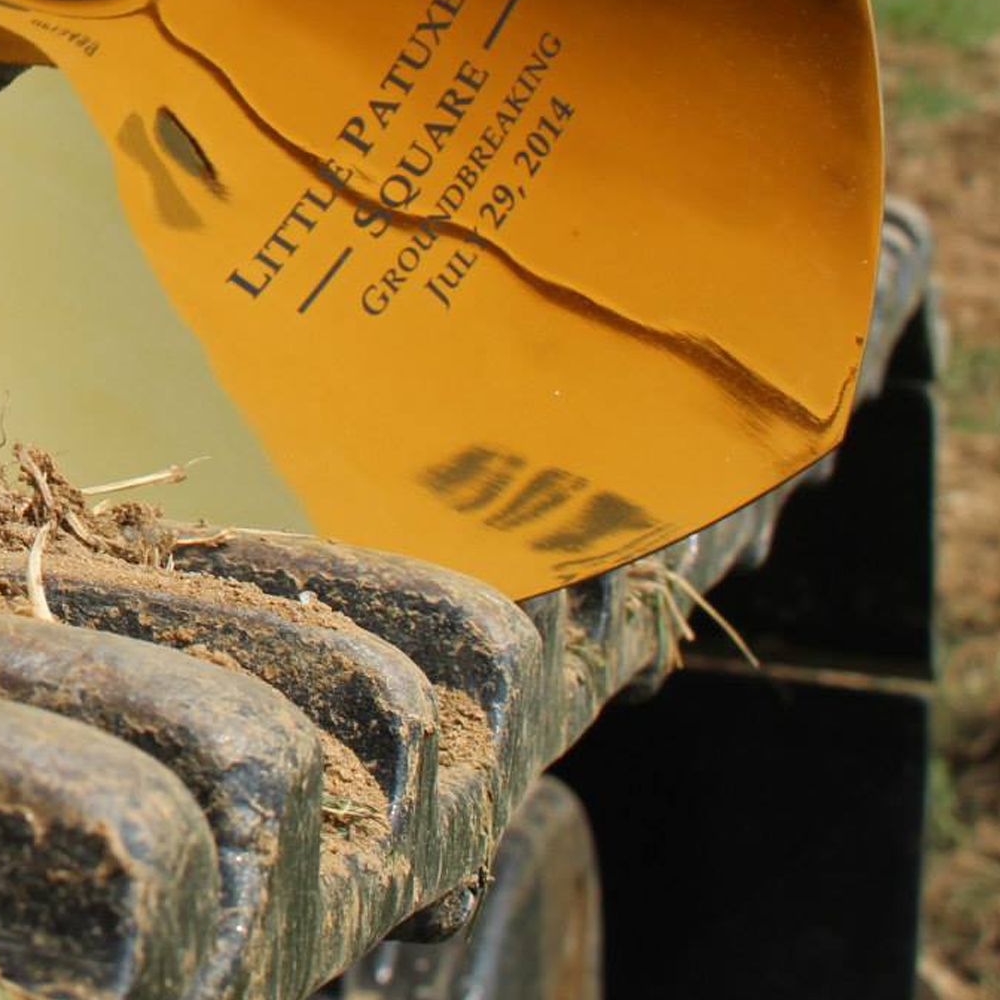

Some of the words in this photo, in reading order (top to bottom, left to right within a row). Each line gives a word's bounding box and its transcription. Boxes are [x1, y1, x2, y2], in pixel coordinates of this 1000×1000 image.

[226, 157, 354, 300] LITTLE
[353, 60, 489, 239] SQUARE
[361, 32, 562, 316] GROUNDBREAKING
[479, 184, 526, 230] 29,
[514, 96, 576, 177] 2014
